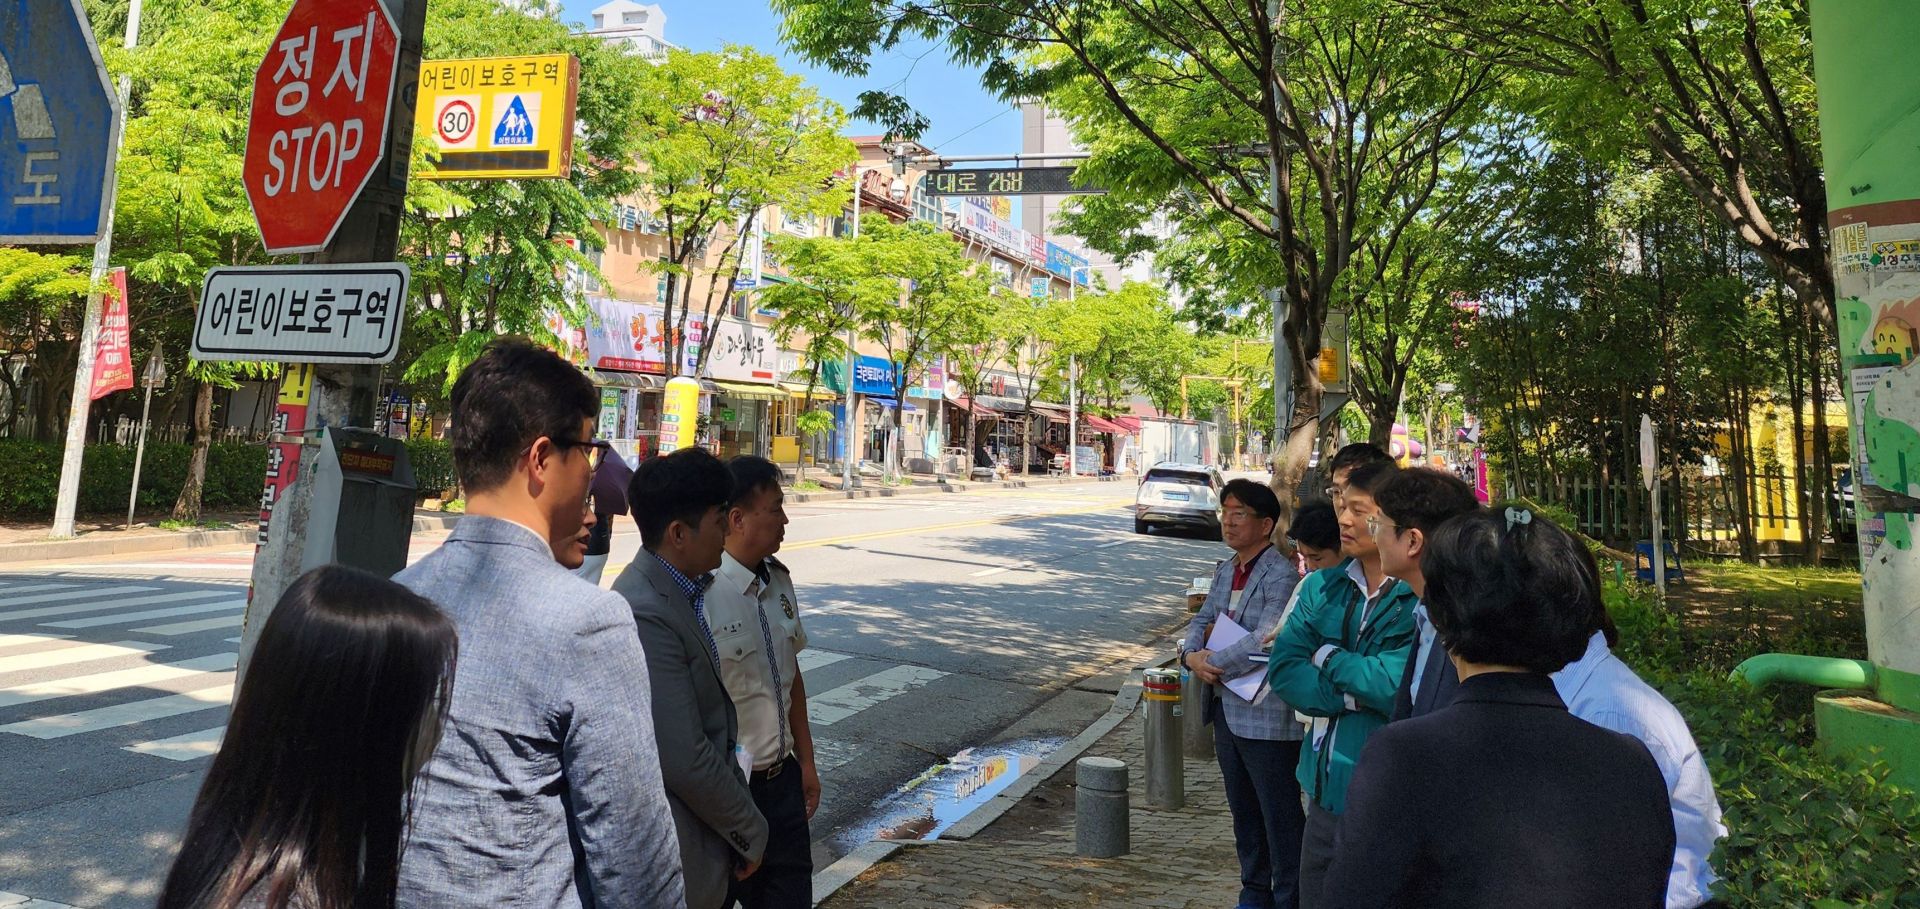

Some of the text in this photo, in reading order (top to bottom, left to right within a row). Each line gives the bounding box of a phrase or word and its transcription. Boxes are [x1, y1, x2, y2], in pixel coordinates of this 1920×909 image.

[272, 12, 377, 117] 정지
[422, 61, 559, 90] 어린이보호구역
[443, 112, 469, 133] 30
[263, 118, 364, 197] STOP
[209, 286, 391, 339] 어린이보호구역
[727, 332, 764, 368] 과일나무
